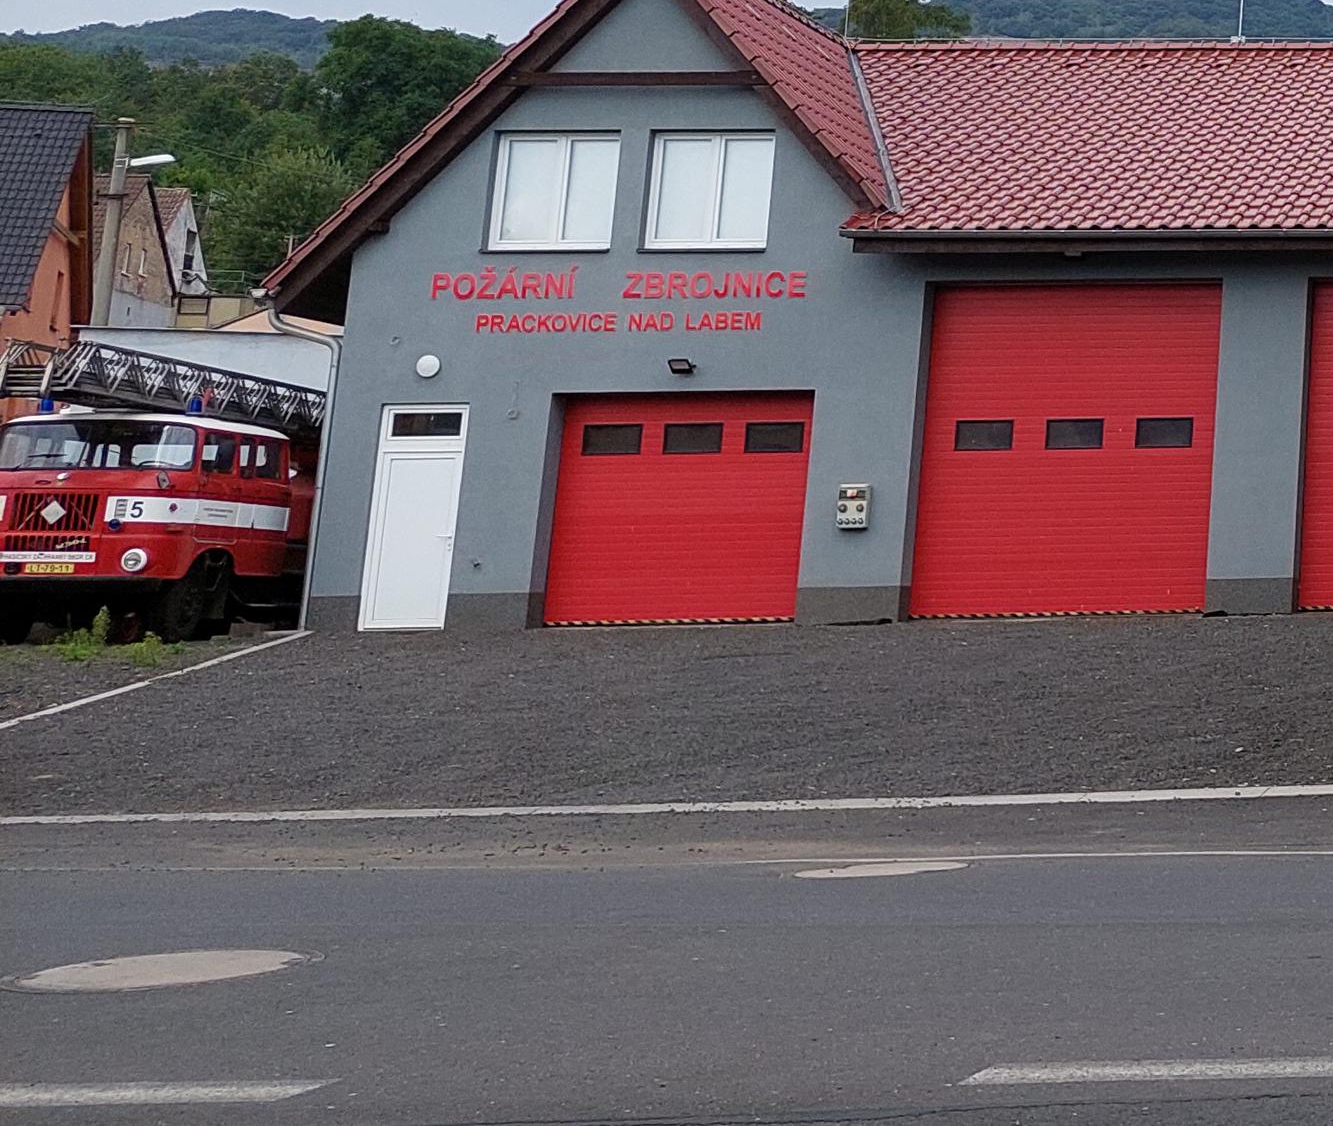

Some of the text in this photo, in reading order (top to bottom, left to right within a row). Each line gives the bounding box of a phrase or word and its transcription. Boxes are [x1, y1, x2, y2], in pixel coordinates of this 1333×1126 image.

[430, 266, 809, 301] POŽÁRNÍ ZBROJNICE
[475, 312, 763, 333] PRACKOVICE NAD LABEM
[130, 501, 144, 518] 5
